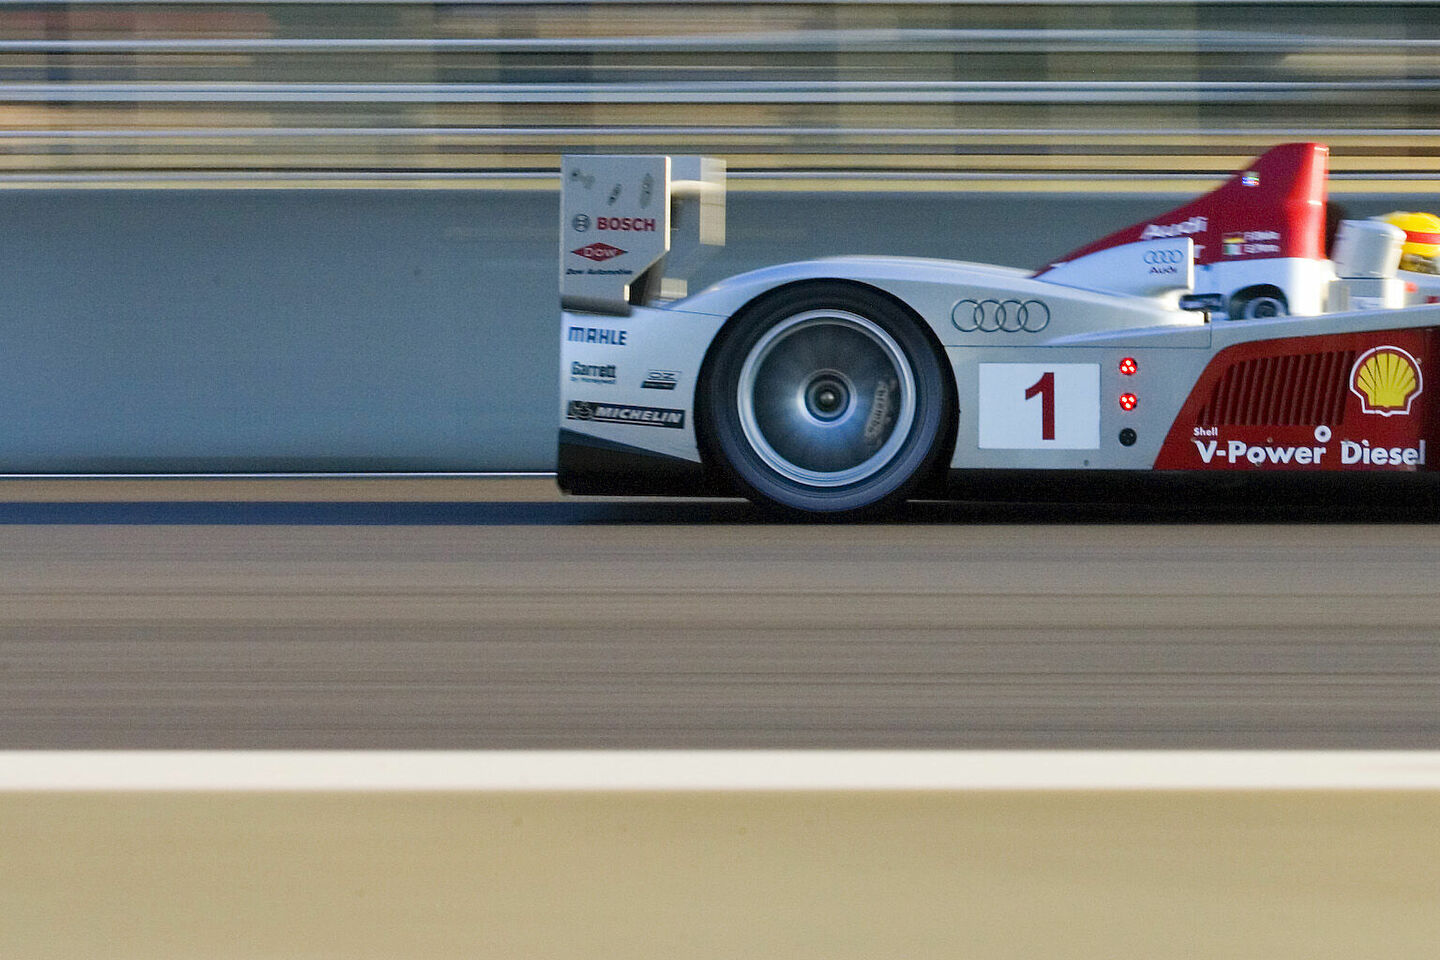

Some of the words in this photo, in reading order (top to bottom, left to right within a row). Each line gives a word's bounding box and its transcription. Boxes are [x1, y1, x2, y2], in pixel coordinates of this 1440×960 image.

[597, 216, 656, 232] BOSCH
[568, 326, 628, 346] MAHLE
[571, 361, 617, 378] Garrett
[595, 406, 682, 423] MICHELIN
[1025, 372, 1055, 440] 1
[1193, 427, 1218, 437] Shell
[1195, 440, 1327, 467] V-Power
[1340, 439, 1426, 466] Diesel
